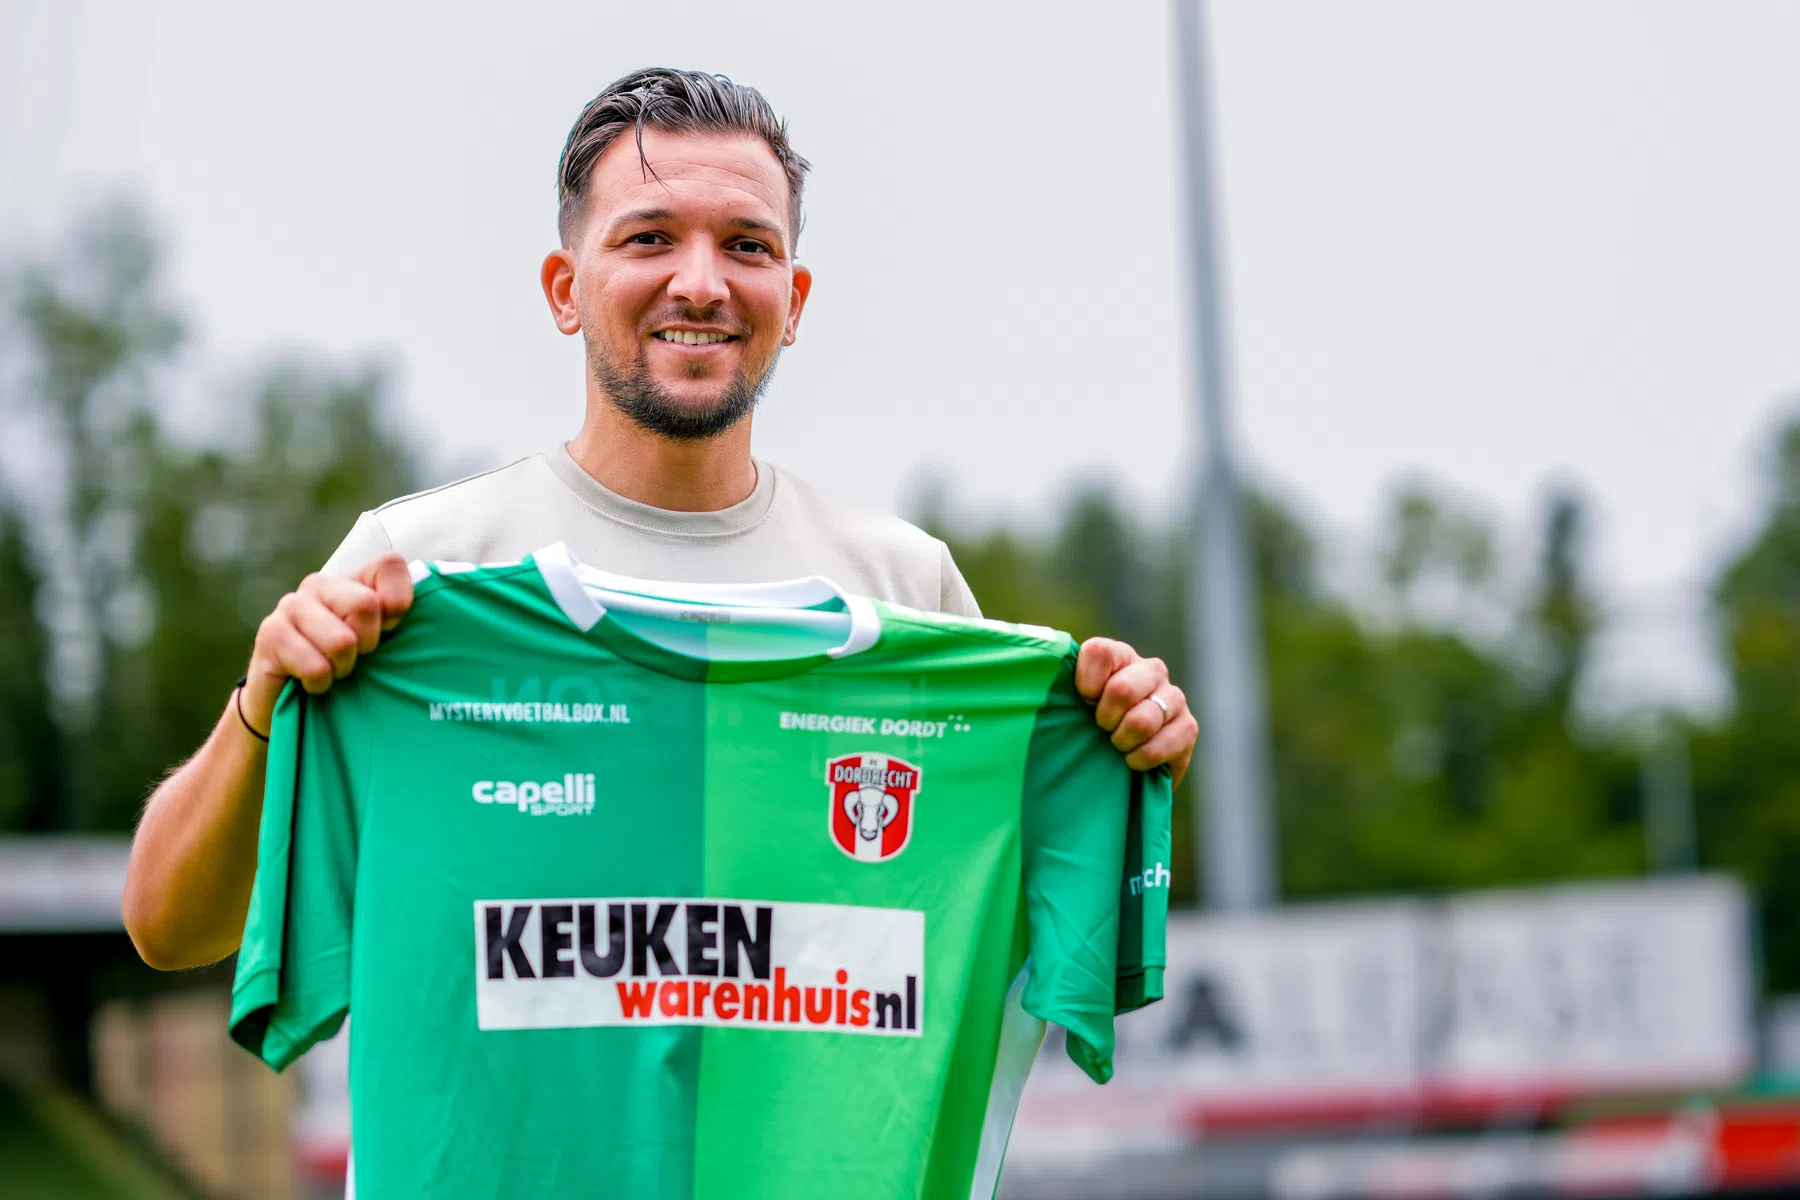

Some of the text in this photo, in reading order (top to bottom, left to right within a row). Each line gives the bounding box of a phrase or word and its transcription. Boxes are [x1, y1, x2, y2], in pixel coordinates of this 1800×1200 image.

[429, 702, 631, 724] MYSTERYVOETBALBOX.NL
[779, 711, 948, 738] ENERGIEK DORDT
[834, 765, 914, 788] DORDRECHT
[472, 773, 596, 813] capelli
[485, 904, 773, 980] KEUKEN
